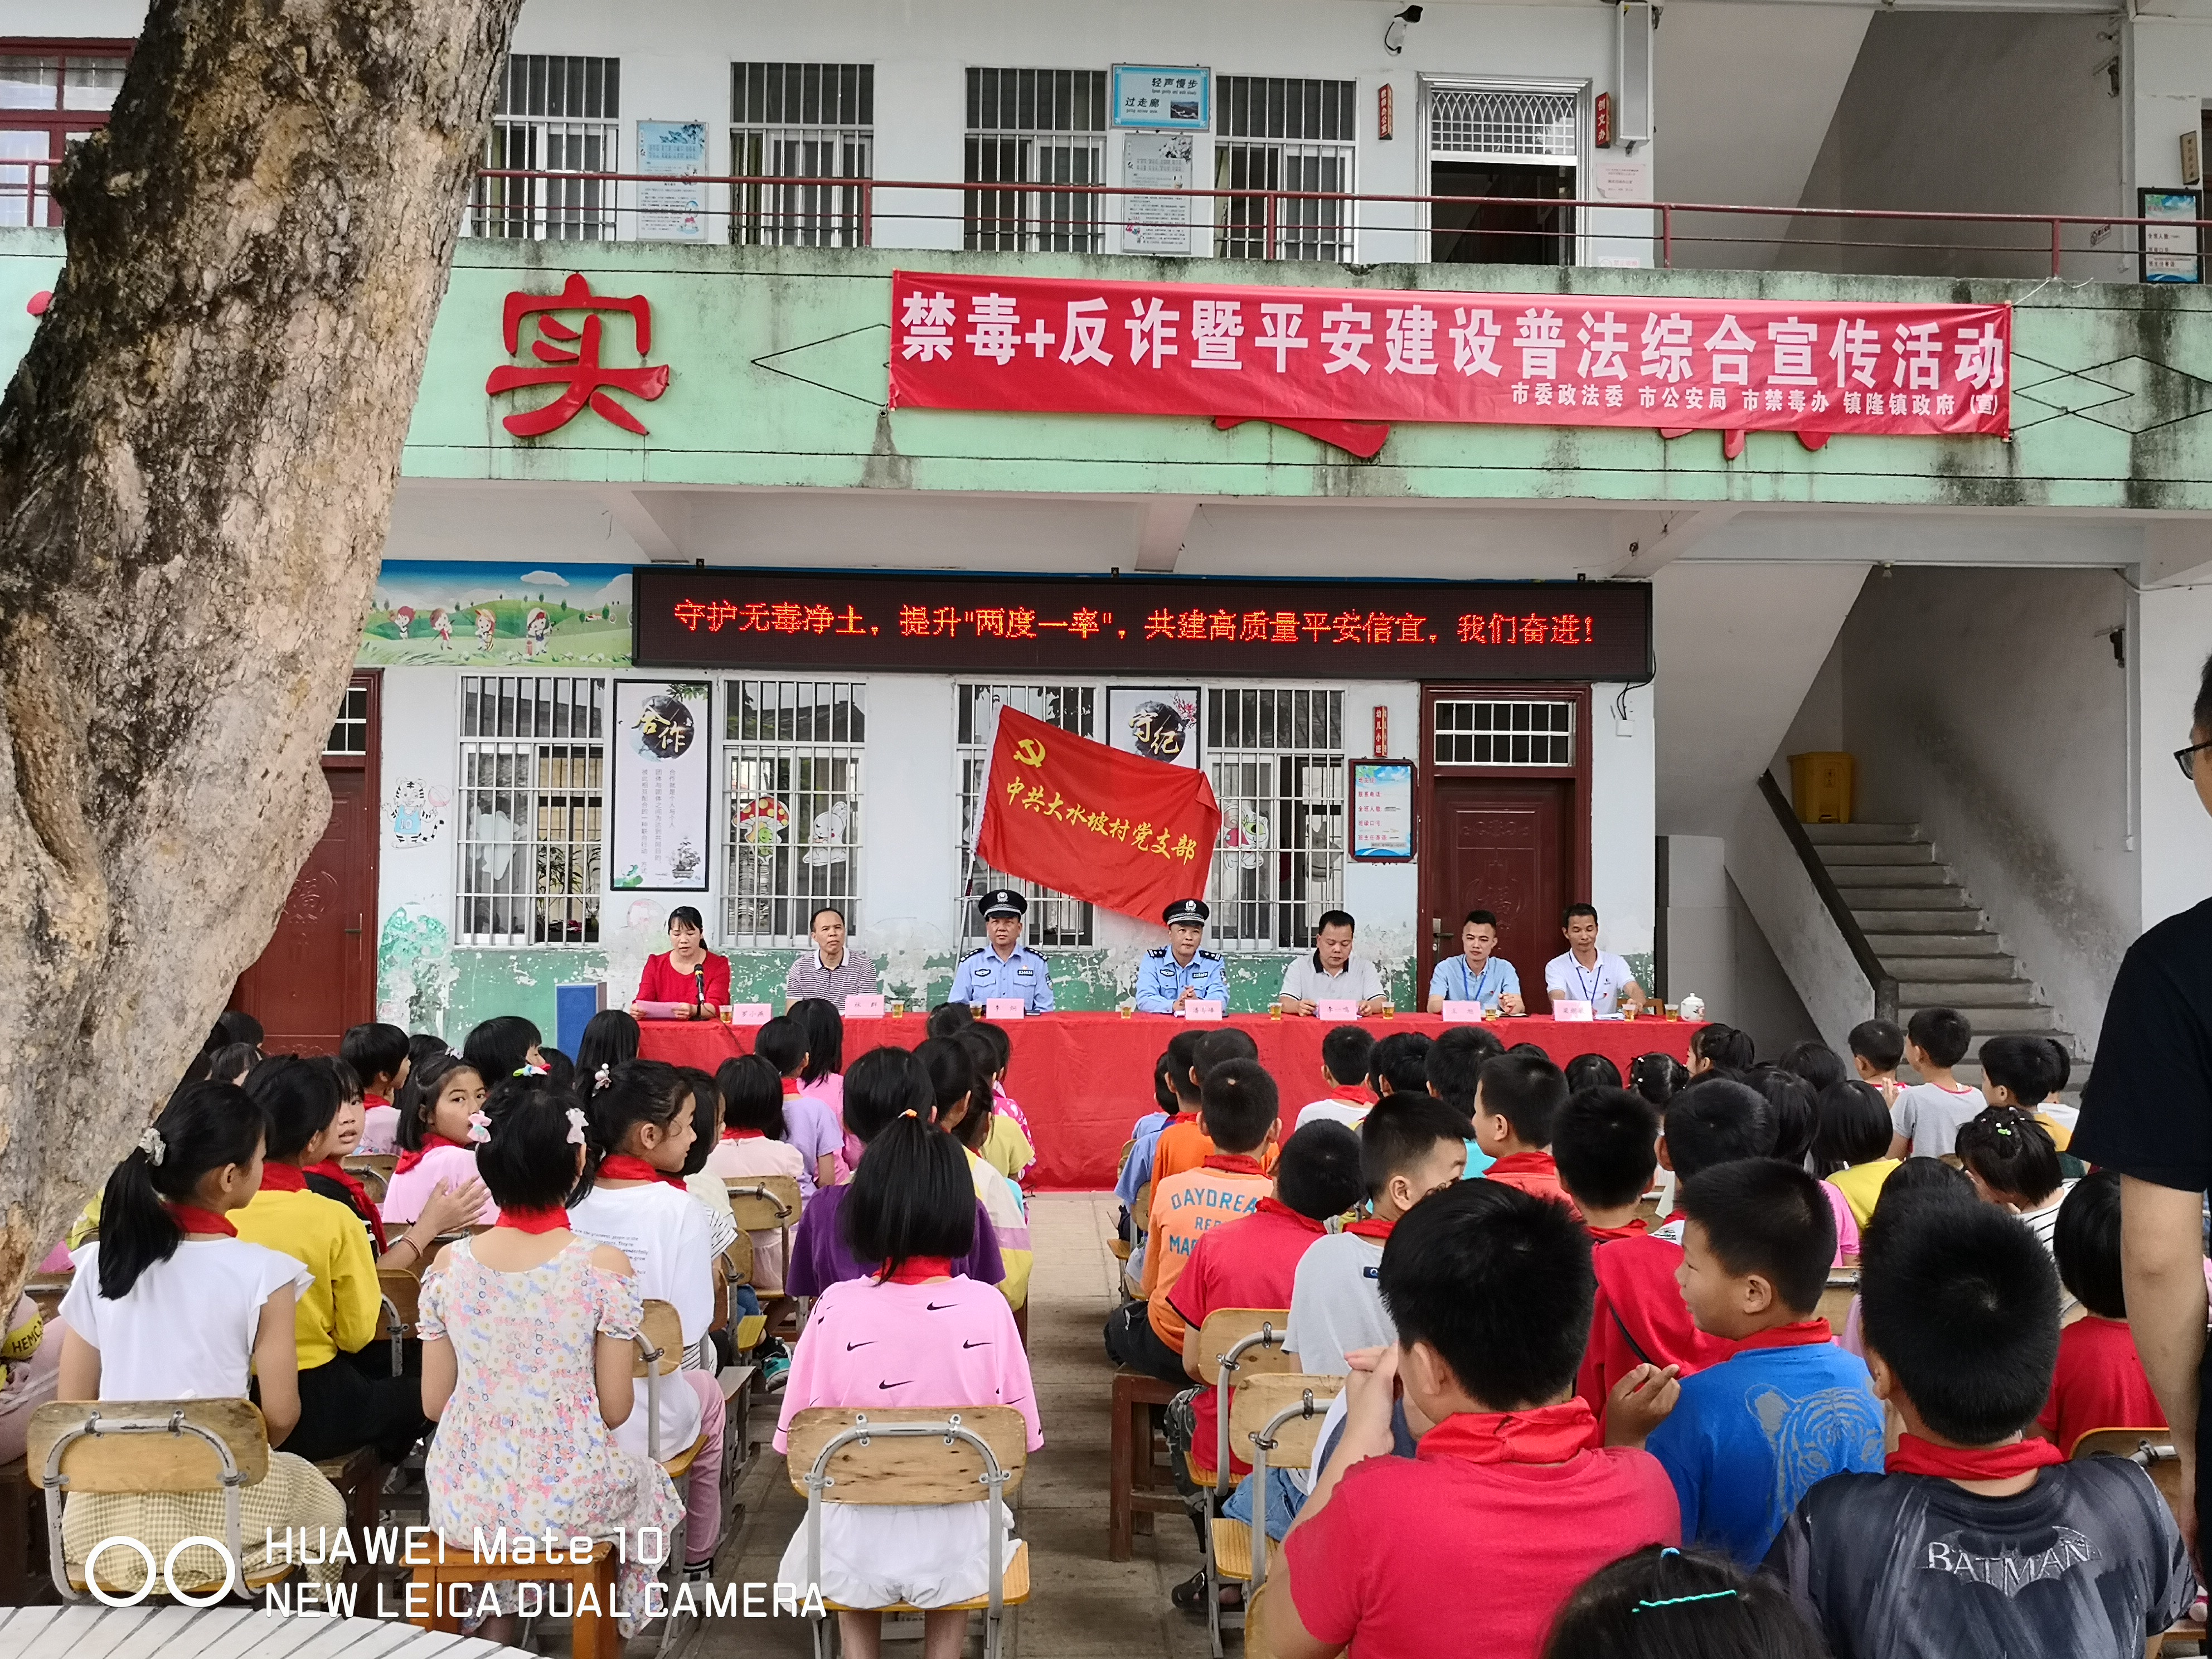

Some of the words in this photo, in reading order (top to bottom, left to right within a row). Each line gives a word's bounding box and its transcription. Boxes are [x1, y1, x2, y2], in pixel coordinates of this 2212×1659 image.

[1125, 97, 1160, 108] 过走廊
[1152, 77, 1198, 89] 轻声慢步
[486, 273, 670, 437] 实
[900, 291, 2006, 390] 禁毒+反诈暨平安建设普法综合宣传活动
[1511, 382, 1623, 408] 市委政法委
[1638, 386, 1727, 410] 市公安局
[1742, 389, 1830, 413] 市禁毒办
[1843, 391, 1955, 415] 镇隆镇政府
[631, 699, 686, 754] 合作
[1129, 710, 1180, 755] 守纪
[1006, 775, 1197, 866] 中共大水坡村党支部
[1928, 1540, 2090, 1594] BATMAN
